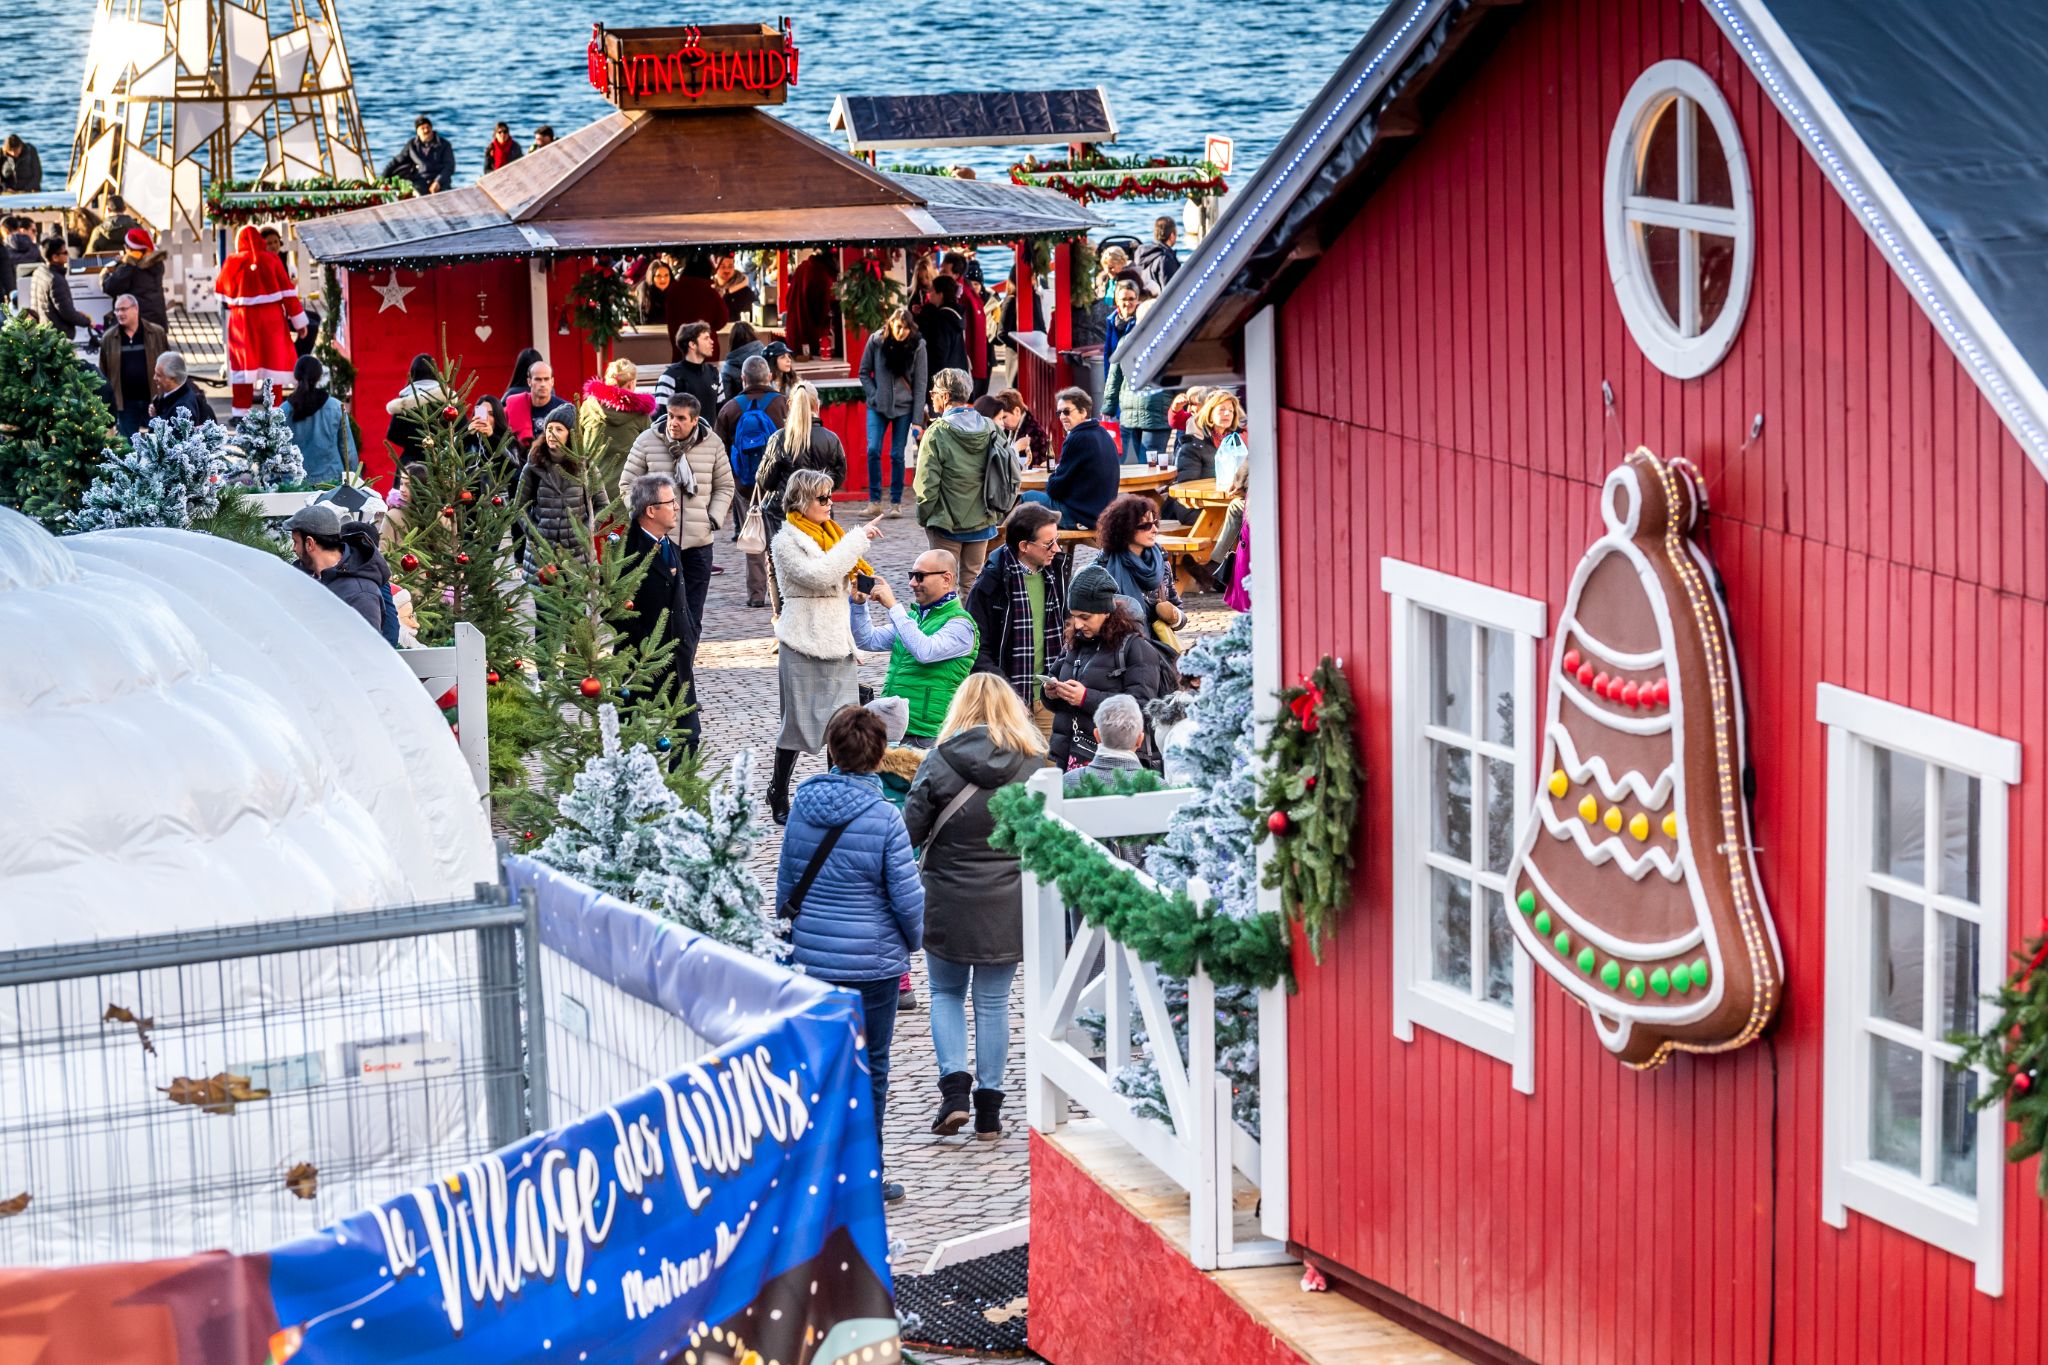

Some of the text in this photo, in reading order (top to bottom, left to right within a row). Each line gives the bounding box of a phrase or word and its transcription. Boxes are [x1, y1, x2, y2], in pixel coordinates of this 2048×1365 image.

[621, 53, 679, 96] VIN
[411, 1148, 616, 1331] Village
[606, 1106, 664, 1195] des
[651, 1045, 809, 1210] Lutins
